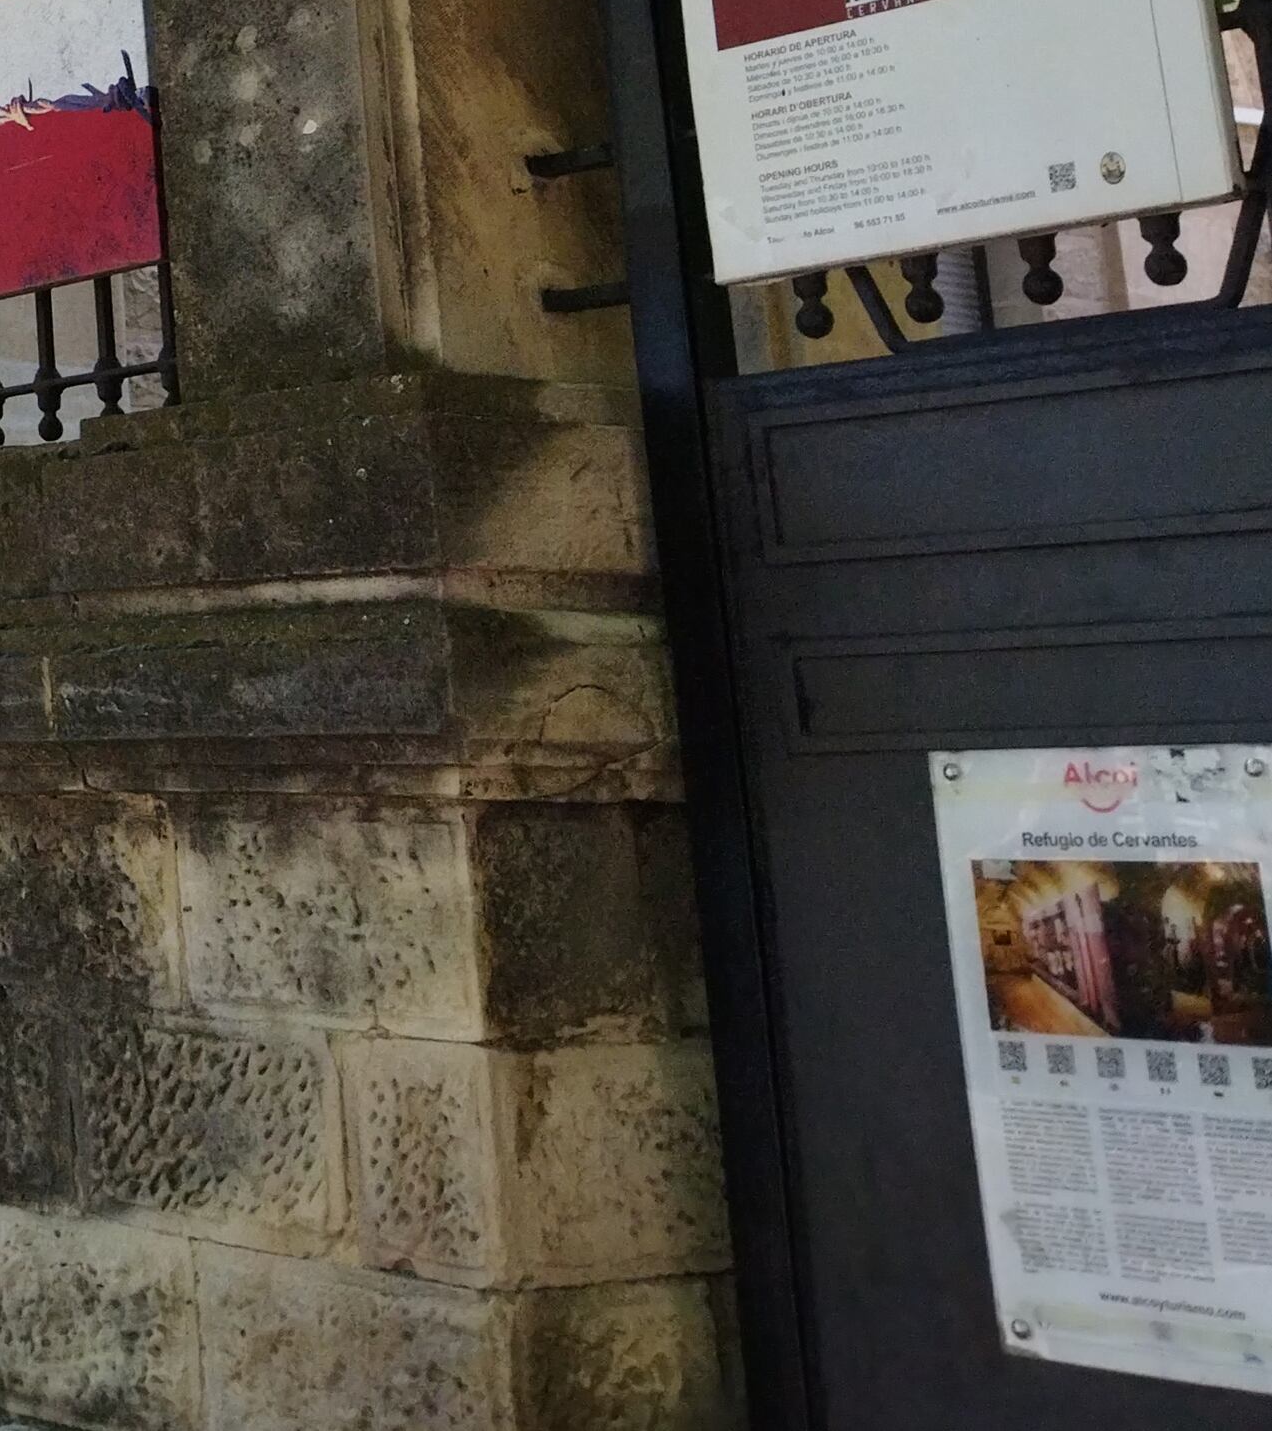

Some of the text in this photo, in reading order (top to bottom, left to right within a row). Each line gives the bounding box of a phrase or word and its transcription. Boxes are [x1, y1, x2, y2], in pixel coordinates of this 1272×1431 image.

[743, 29, 857, 62] HORARIO DE APERTURA
[751, 104, 787, 120] HORARI
[759, 160, 839, 182] OPENING HOURS
[1063, 761, 1138, 787] Alcoi
[1021, 831, 1198, 851] Refugio de Cervantes
